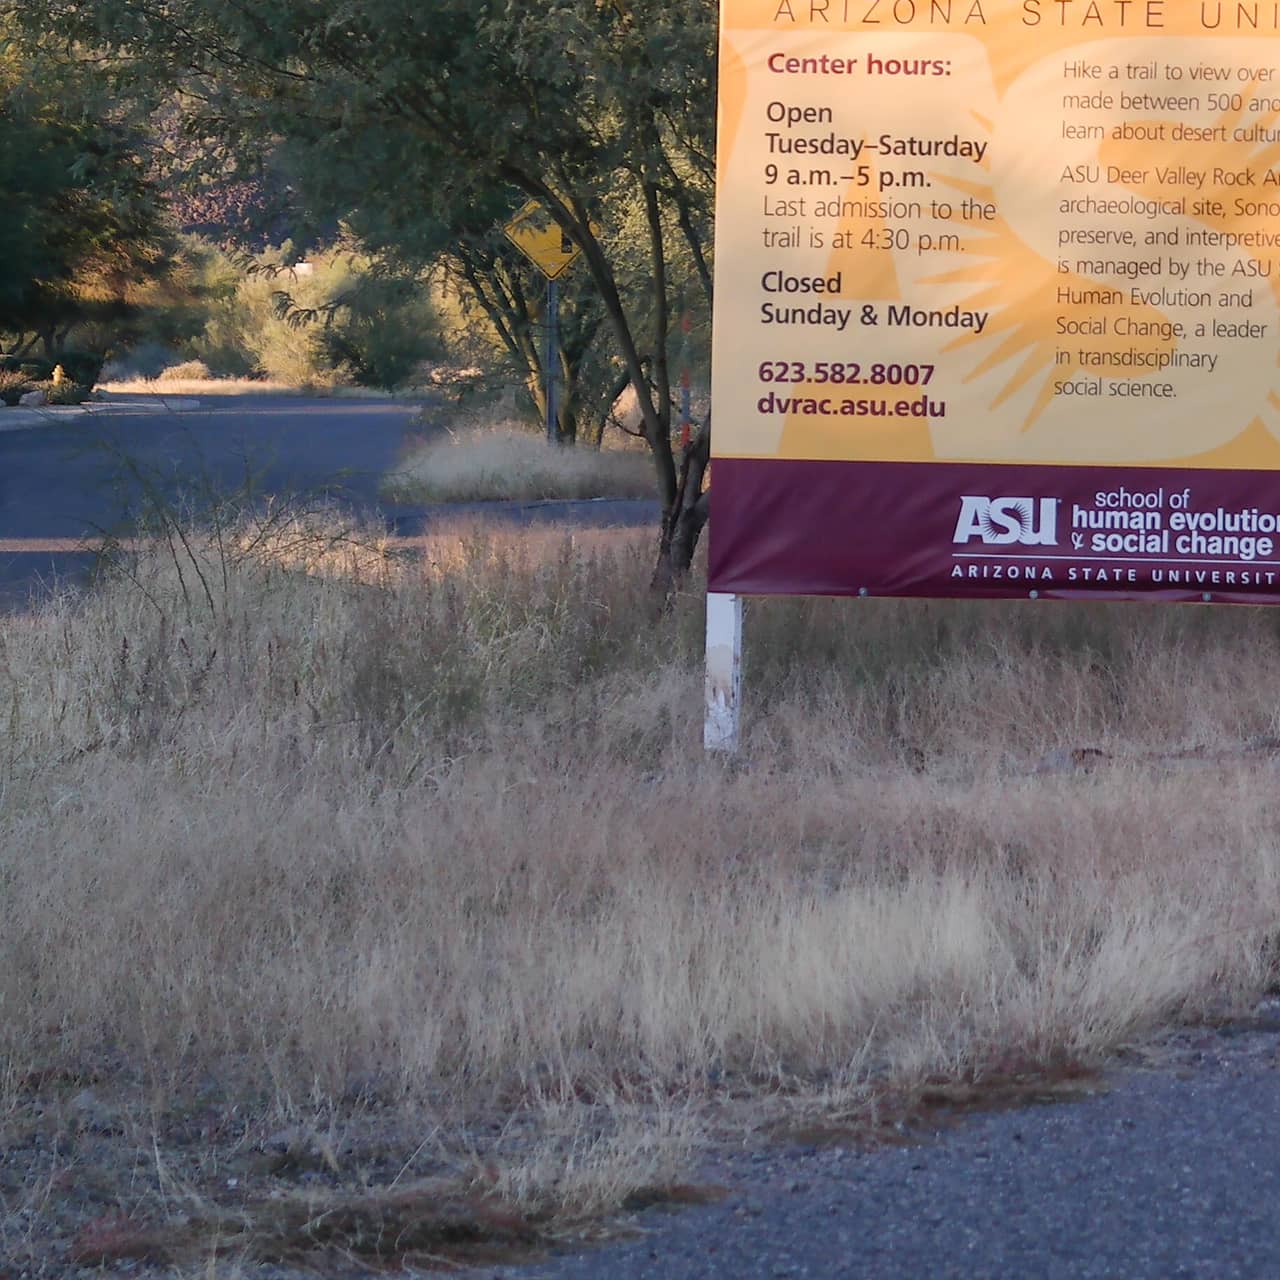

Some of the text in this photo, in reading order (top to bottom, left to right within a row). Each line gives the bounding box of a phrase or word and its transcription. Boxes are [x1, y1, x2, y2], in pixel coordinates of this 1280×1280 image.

[768, 53, 951, 76] Center hours:
[1064, 60, 1102, 79] Hike
[1108, 66, 1120, 79] a
[1125, 61, 1157, 80] trail
[1165, 64, 1184, 84] to
[1189, 62, 1231, 81] view
[1237, 68, 1276, 83] over
[1063, 91, 1113, 109] made
[1121, 91, 1199, 111] between
[1208, 93, 1246, 112] 500
[767, 102, 832, 128] Open
[1062, 120, 1104, 139] learn
[1112, 120, 1169, 141] about
[1172, 122, 1227, 142] desert
[765, 164, 778, 184] 9
[880, 171, 931, 192] p.m.
[1060, 165, 1099, 183] ASU
[1107, 166, 1149, 184] Deer
[1156, 166, 1207, 190] Valley
[1213, 167, 1256, 187] Rock
[764, 195, 996, 220] Last admission to the
[1059, 194, 1188, 219] archaeological
[1190, 198, 1227, 220] site,
[762, 226, 964, 256] trail is at 4:30 p.m.
[1059, 230, 1136, 248] preserve,
[1144, 226, 1179, 246] and
[1058, 256, 1071, 274] is
[1077, 256, 1162, 280] managed
[1169, 256, 1190, 280] by
[1196, 257, 1225, 277] the
[1230, 259, 1271, 277] ASU
[761, 270, 841, 293] Closed
[1057, 286, 1252, 308] Human Evolution and
[761, 302, 988, 334] Sunday & Monday
[1056, 316, 1267, 341] Social Change, a leader
[1055, 347, 1218, 372] in transdisciplinary
[759, 361, 934, 385] 623.582.8007
[1054, 376, 1176, 397] social science.
[757, 392, 945, 417] dvrac.asu.edu
[1095, 487, 1190, 509] school of
[952, 496, 1058, 545] ASU
[1072, 505, 1161, 529] human
[1091, 531, 1168, 553] social
[1175, 530, 1273, 560] change
[952, 565, 1052, 579] ARIZONA
[1069, 568, 1136, 581] STATE
